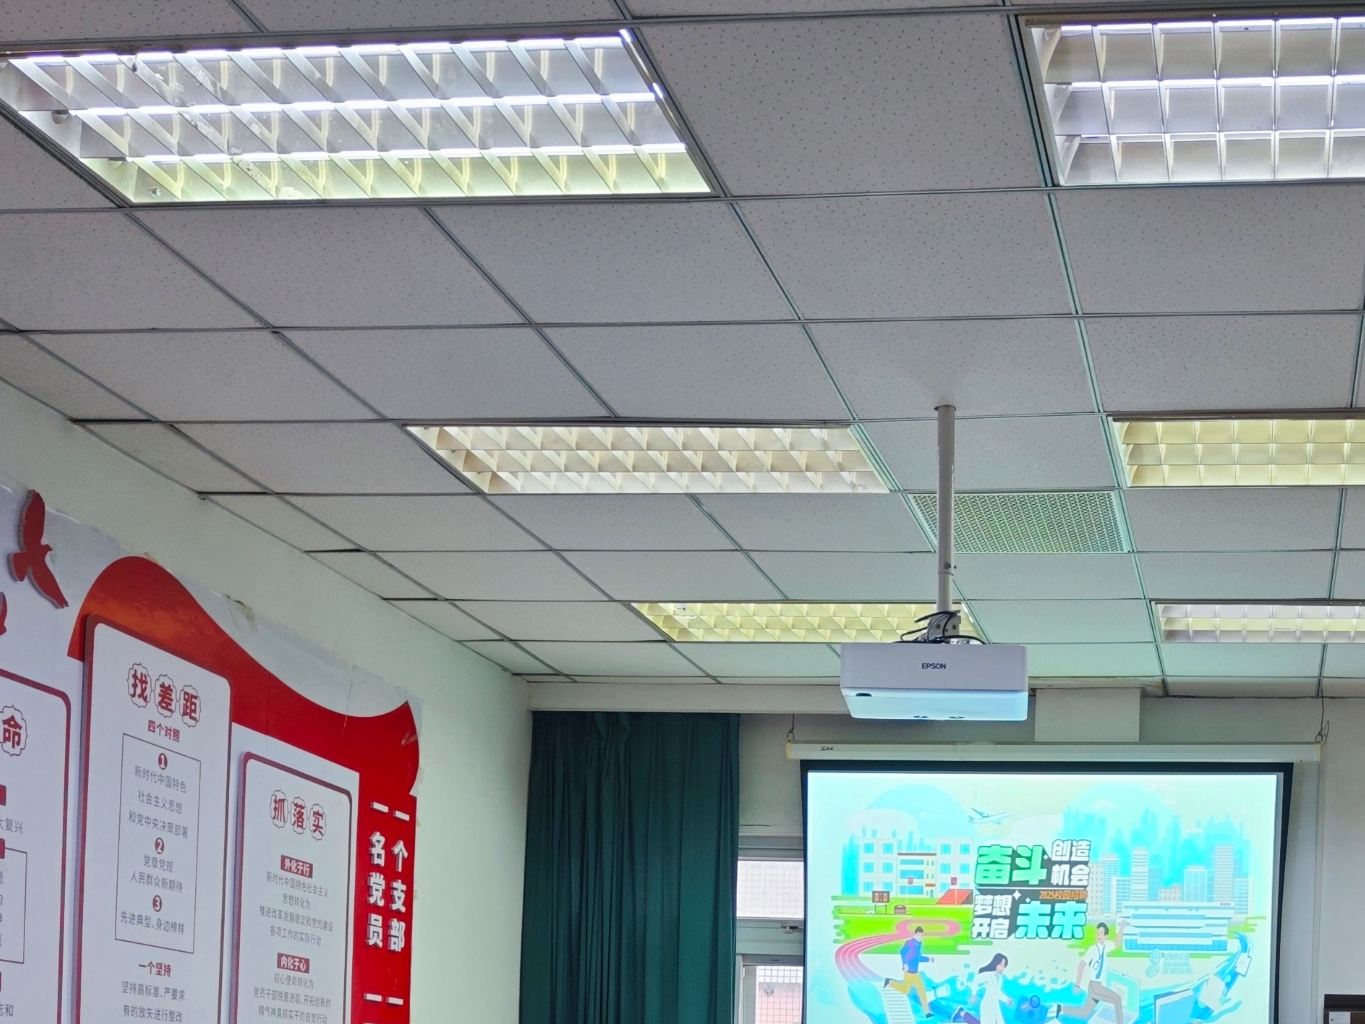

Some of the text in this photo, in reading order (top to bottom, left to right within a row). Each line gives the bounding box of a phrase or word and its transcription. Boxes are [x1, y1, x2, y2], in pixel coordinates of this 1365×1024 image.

[131, 669, 199, 722] 找差距
[148, 719, 181, 743] 四个对照
[134, 765, 187, 794] 新时代中国特色
[138, 790, 183, 814] 社会主义思想
[128, 810, 188, 839] 和党中央决策部署
[273, 795, 324, 836] 抓落实
[1051, 839, 1091, 861] 创造
[143, 854, 174, 873] 党章党规
[283, 858, 310, 877] 外化于行
[366, 801, 389, 948] 一名党员
[975, 844, 1048, 885] 奋斗
[1051, 864, 1091, 886] 机会
[130, 870, 183, 894] 人民群众新期待
[266, 871, 329, 898] 新时代中国特色社会主义
[388, 810, 410, 952] 一个支部
[282, 893, 311, 910] 思想转化为
[973, 894, 1013, 916] 梦想
[1040, 890, 1088, 900] 2025校园招聘
[120, 911, 185, 935] 先进典型、身边榜样
[259, 905, 334, 932] 推进改革发展稳定和党的建设
[971, 917, 1010, 940] 开启
[1014, 901, 1088, 940] 未来
[270, 925, 322, 946] 各项工作的实际行动
[138, 961, 172, 978] 一个坚持
[280, 955, 307, 972] 内化于心
[121, 981, 185, 1001] 坚持高标准、严要求
[274, 973, 314, 989] 初心使命转化为
[123, 1004, 183, 1023] 有的放矢进行整改
